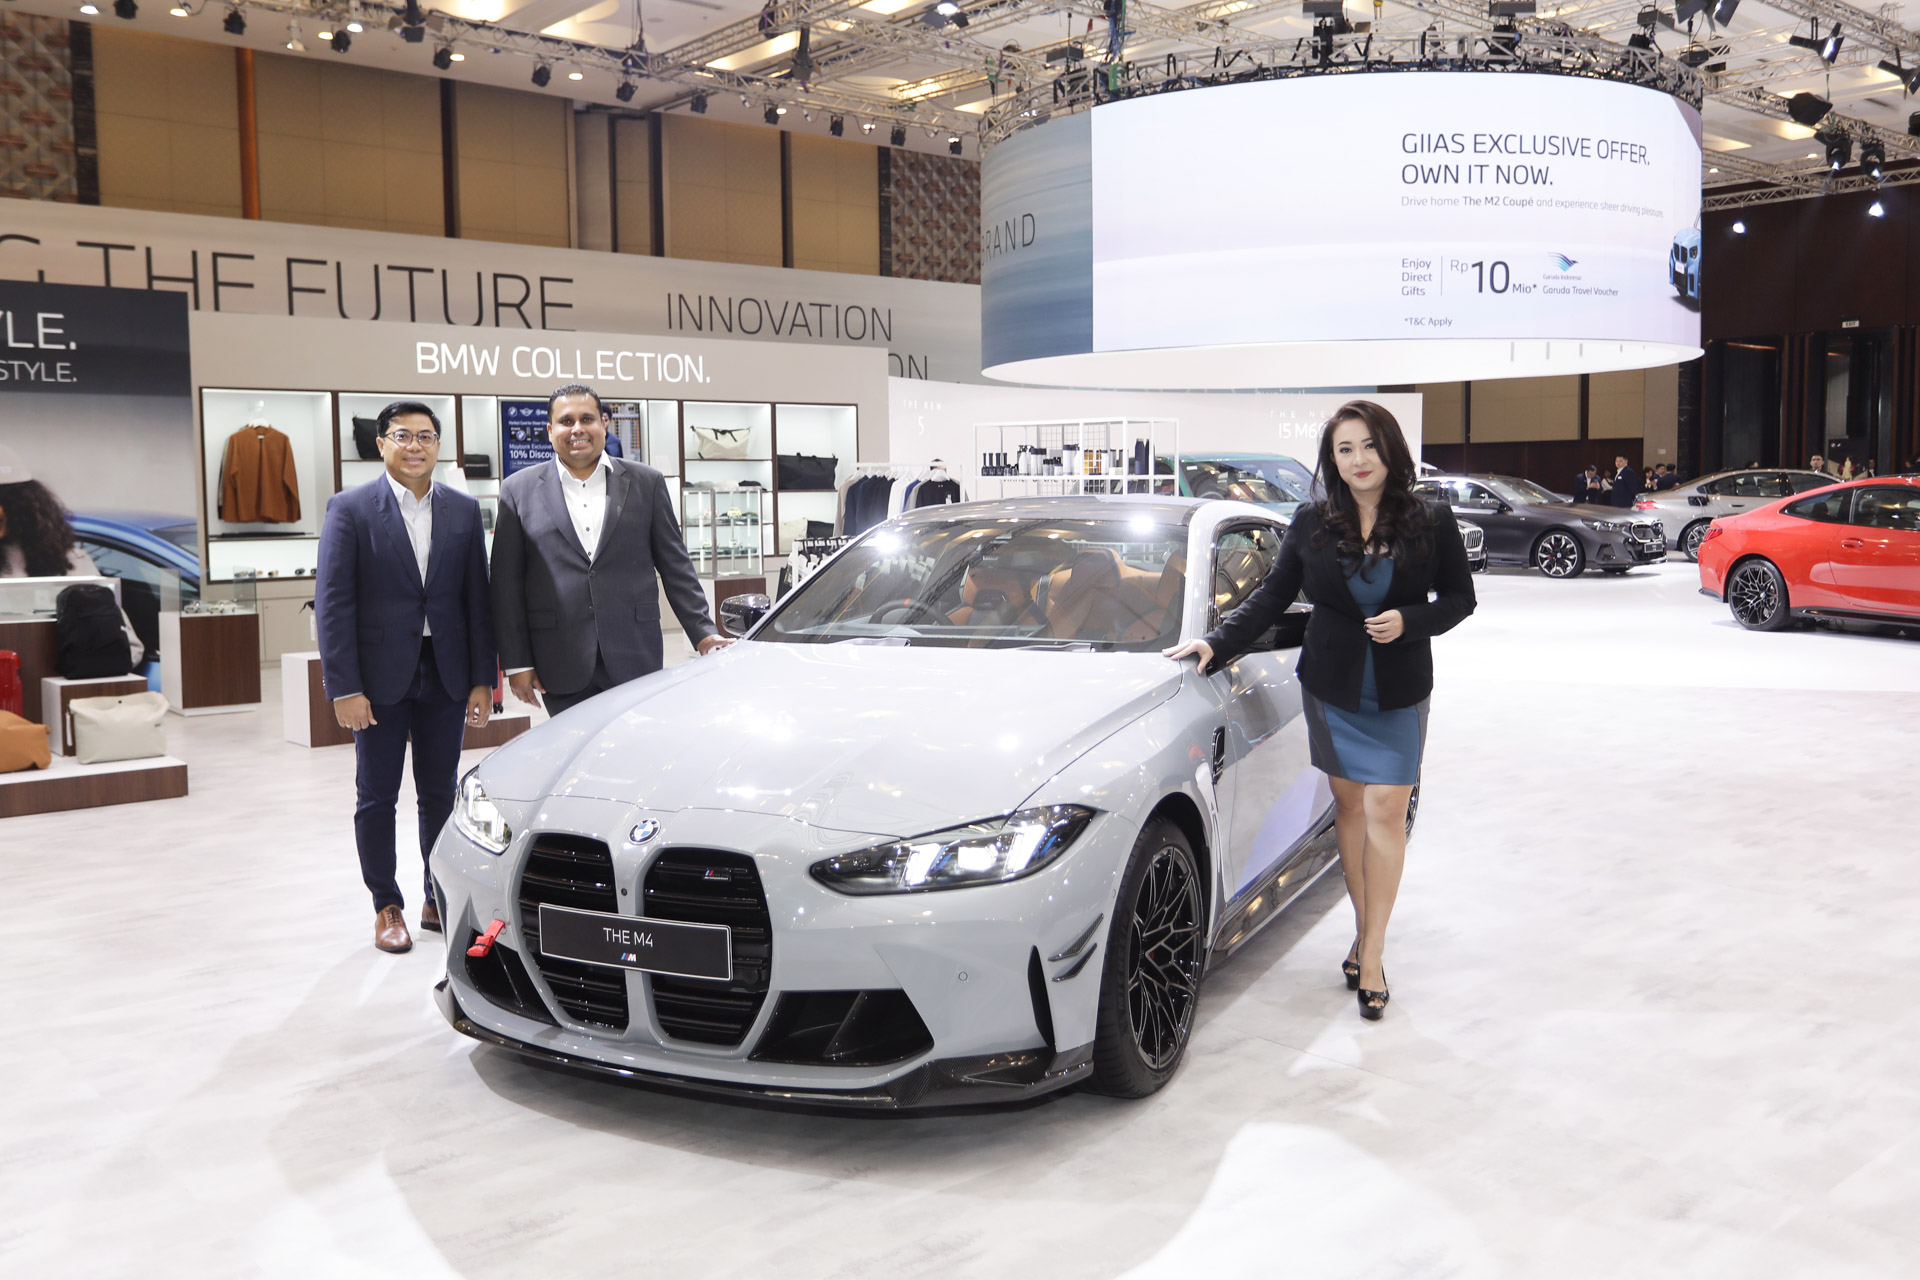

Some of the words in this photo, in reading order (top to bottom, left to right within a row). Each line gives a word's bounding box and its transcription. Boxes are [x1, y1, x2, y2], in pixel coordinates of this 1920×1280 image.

[1402, 133, 1465, 153] GIIAS
[1473, 133, 1591, 157] EXCLUSIVE
[1597, 139, 1650, 165] OFFER.
[1402, 164, 1459, 184] OWN
[1468, 164, 1489, 184] IT
[1496, 165, 1553, 185] NOW.
[1401, 196, 1428, 206] Drive
[1430, 196, 1459, 206] home
[1462, 196, 1481, 206] The
[1484, 196, 1500, 206] M2
[1502, 195, 1534, 208] Coupé
[1536, 197, 1553, 208] and
[1555, 198, 1599, 210] experience
[1600, 201, 1620, 212] sheer
[1620, 203, 1641, 216] driving
[981, 213, 1035, 265] RAND
[1401, 258, 1432, 270] Enjoy
[1401, 272, 1433, 282] Direct
[1450, 260, 1469, 274] Rp
[1471, 261, 1510, 294] 10
[1401, 286, 1426, 296] Gifts
[1542, 285, 1571, 295] Garuda
[1572, 286, 1593, 296] Travel
[1593, 287, 1619, 297] Voucher
[667, 292, 892, 342] INNOVATION
[1427, 317, 1453, 328] Apply
[0, 310, 77, 350] LE.
[416, 341, 500, 376] BMW
[512, 346, 711, 383] COLLECTION.
[510, 450, 528, 459] 10%
[529, 450, 556, 459] Discou
[603, 927, 630, 945] THE
[634, 931, 653, 948] M4
